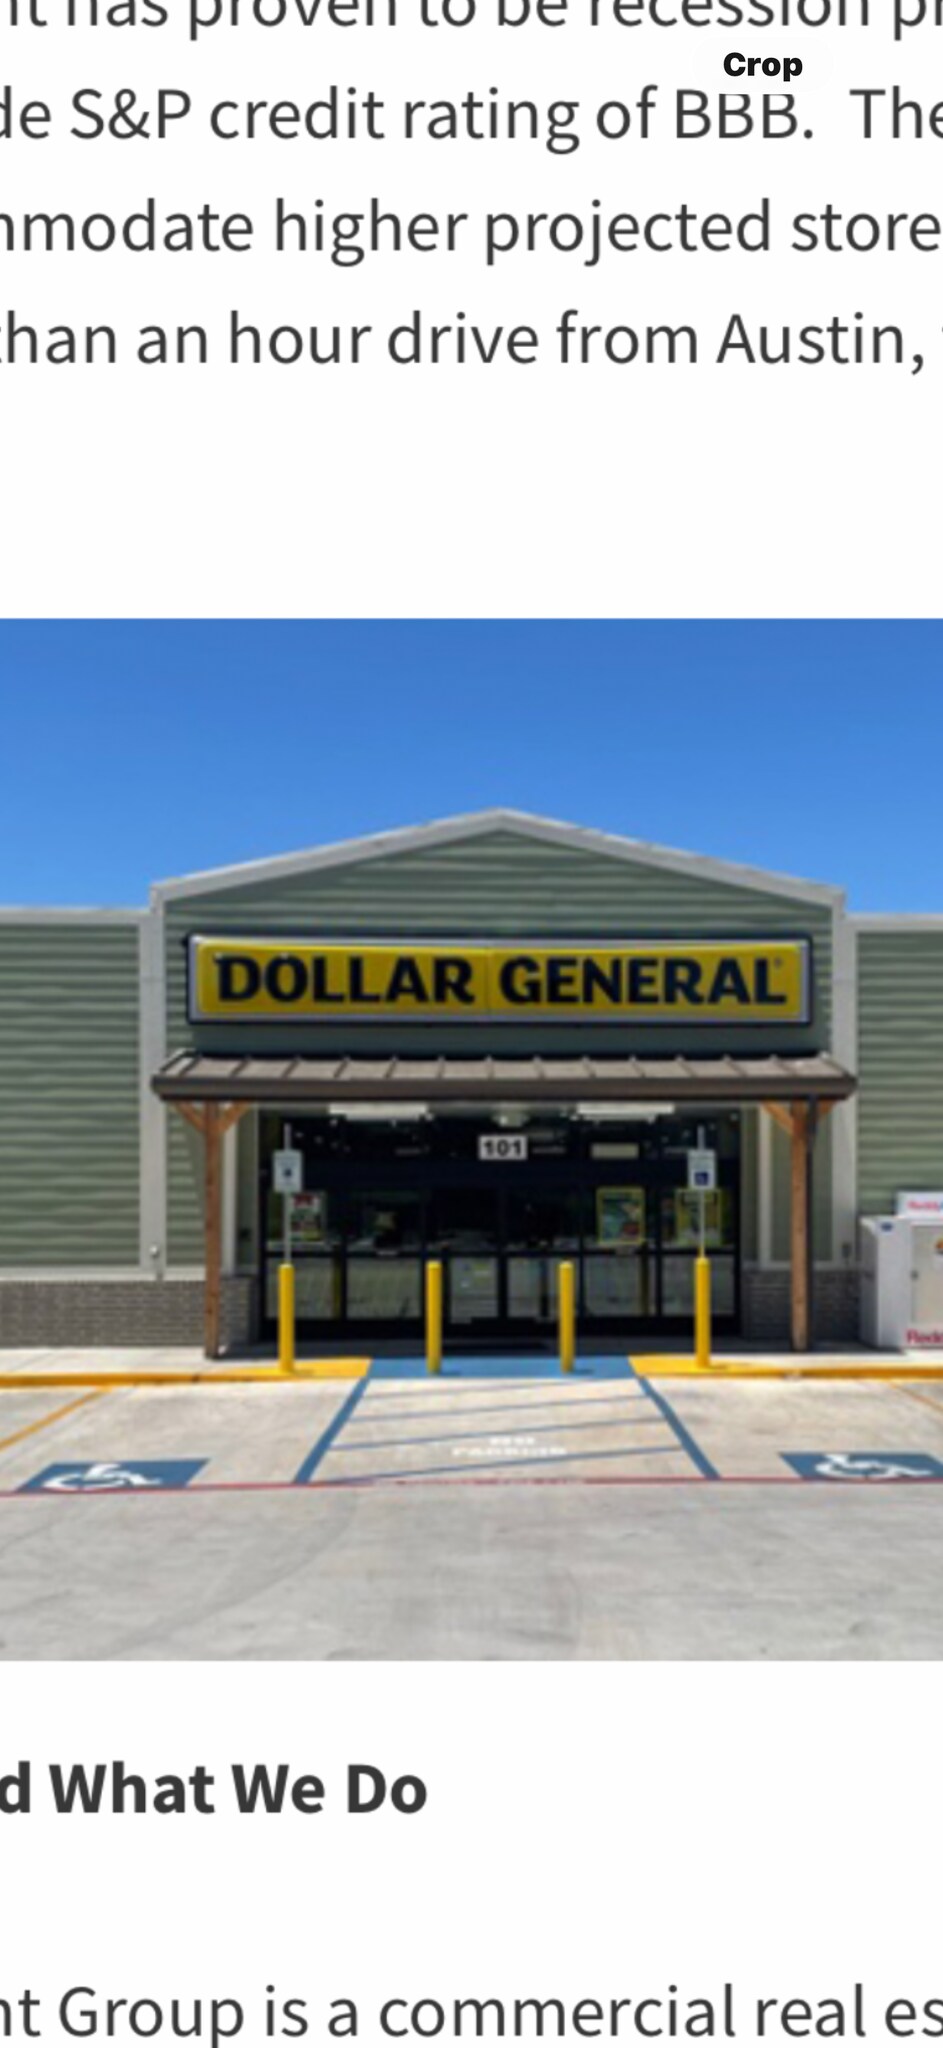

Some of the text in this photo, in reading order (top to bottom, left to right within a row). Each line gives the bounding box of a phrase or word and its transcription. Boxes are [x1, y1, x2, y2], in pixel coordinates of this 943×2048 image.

[68, 0, 168, 27] has
[190, 0, 396, 41] proven
[420, 0, 476, 27] to
[498, 0, 568, 27] be
[591, 0, 869, 27] recession
[70, 88, 191, 140] S&P
[210, 85, 385, 140] credit
[405, 86, 580, 155] rating
[596, 84, 658, 140] of
[676, 88, 813, 140] BBB.
[0, 197, 941, 268] modate higher projected store
[0, 309, 924, 375] han an hour drive from Austin,
[215, 956, 788, 1004] DOLLAR GENERAL
[483, 1139, 521, 1157] 101
[48, 1760, 215, 1814] What
[231, 1764, 325, 1814] We
[347, 1764, 427, 1814] Do
[59, 1986, 244, 2048] Group
[266, 1984, 308, 2038] is
[328, 1998, 358, 2037] a
[379, 1983, 737, 2037] commercial
[757, 1983, 866, 2037] real
